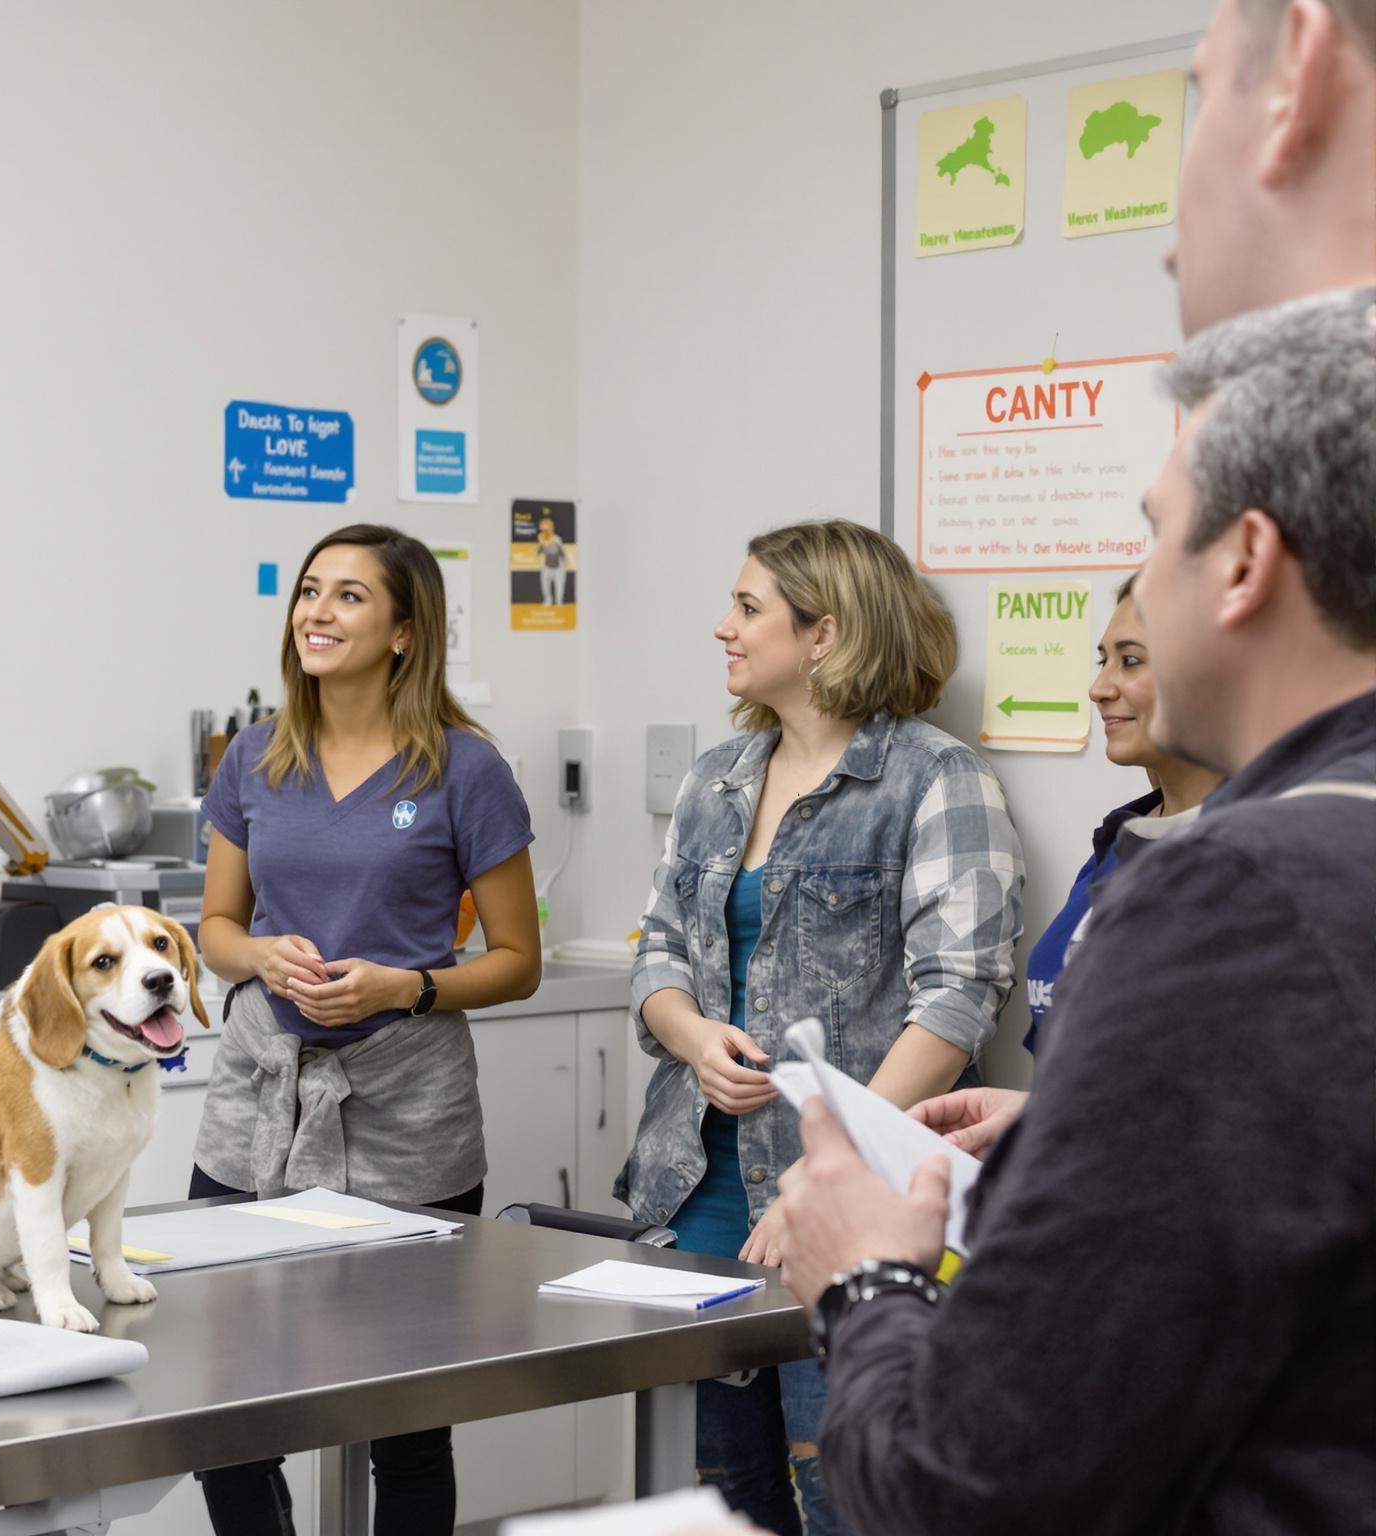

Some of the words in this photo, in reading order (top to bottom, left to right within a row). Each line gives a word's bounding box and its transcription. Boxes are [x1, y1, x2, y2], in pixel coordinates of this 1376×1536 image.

[985, 379, 1104, 424] CANTY
[287, 413, 305, 433] To
[265, 434, 309, 458] LOVE
[997, 591, 1089, 620] PANTUY
